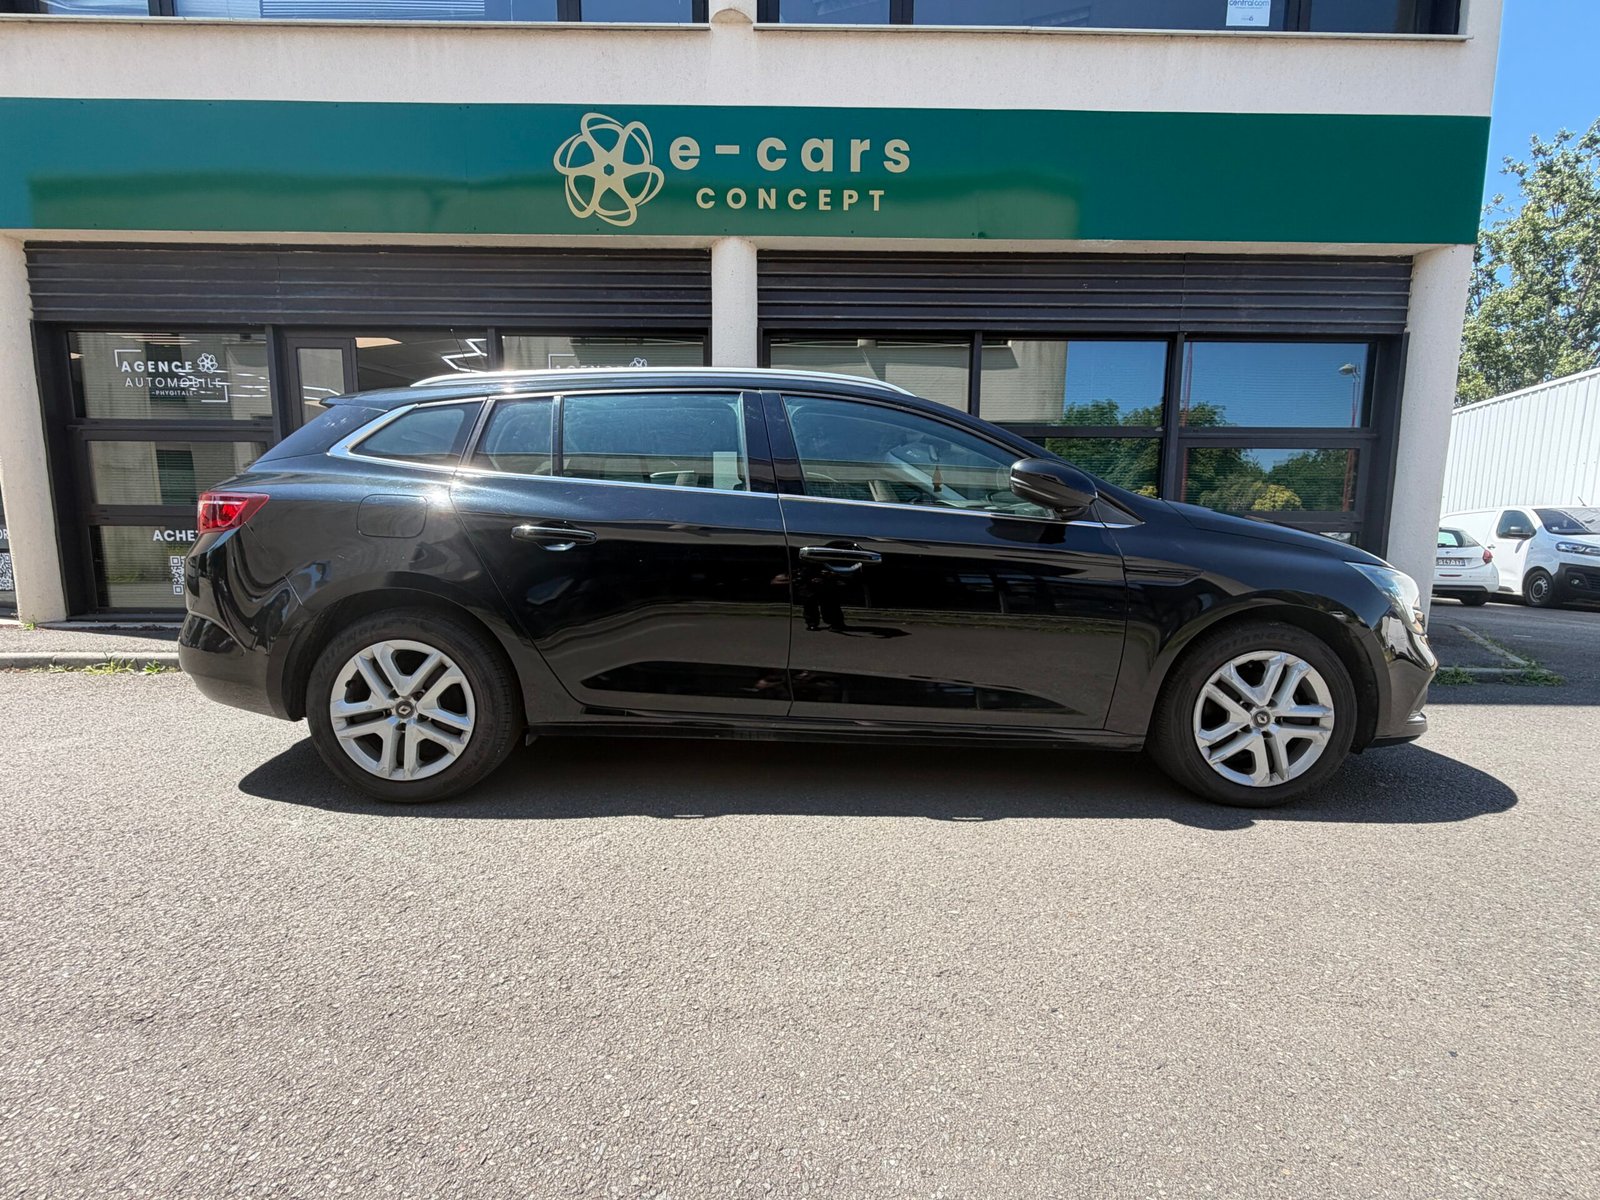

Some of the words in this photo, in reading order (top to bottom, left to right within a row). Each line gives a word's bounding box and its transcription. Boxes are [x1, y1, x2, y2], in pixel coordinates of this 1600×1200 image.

[669, 136, 910, 173] e-cars
[696, 188, 885, 212] CONCEPT
[121, 361, 193, 373] AGENCE
[125, 378, 222, 388] AUTOMOBILE
[153, 530, 198, 541] ACHE
